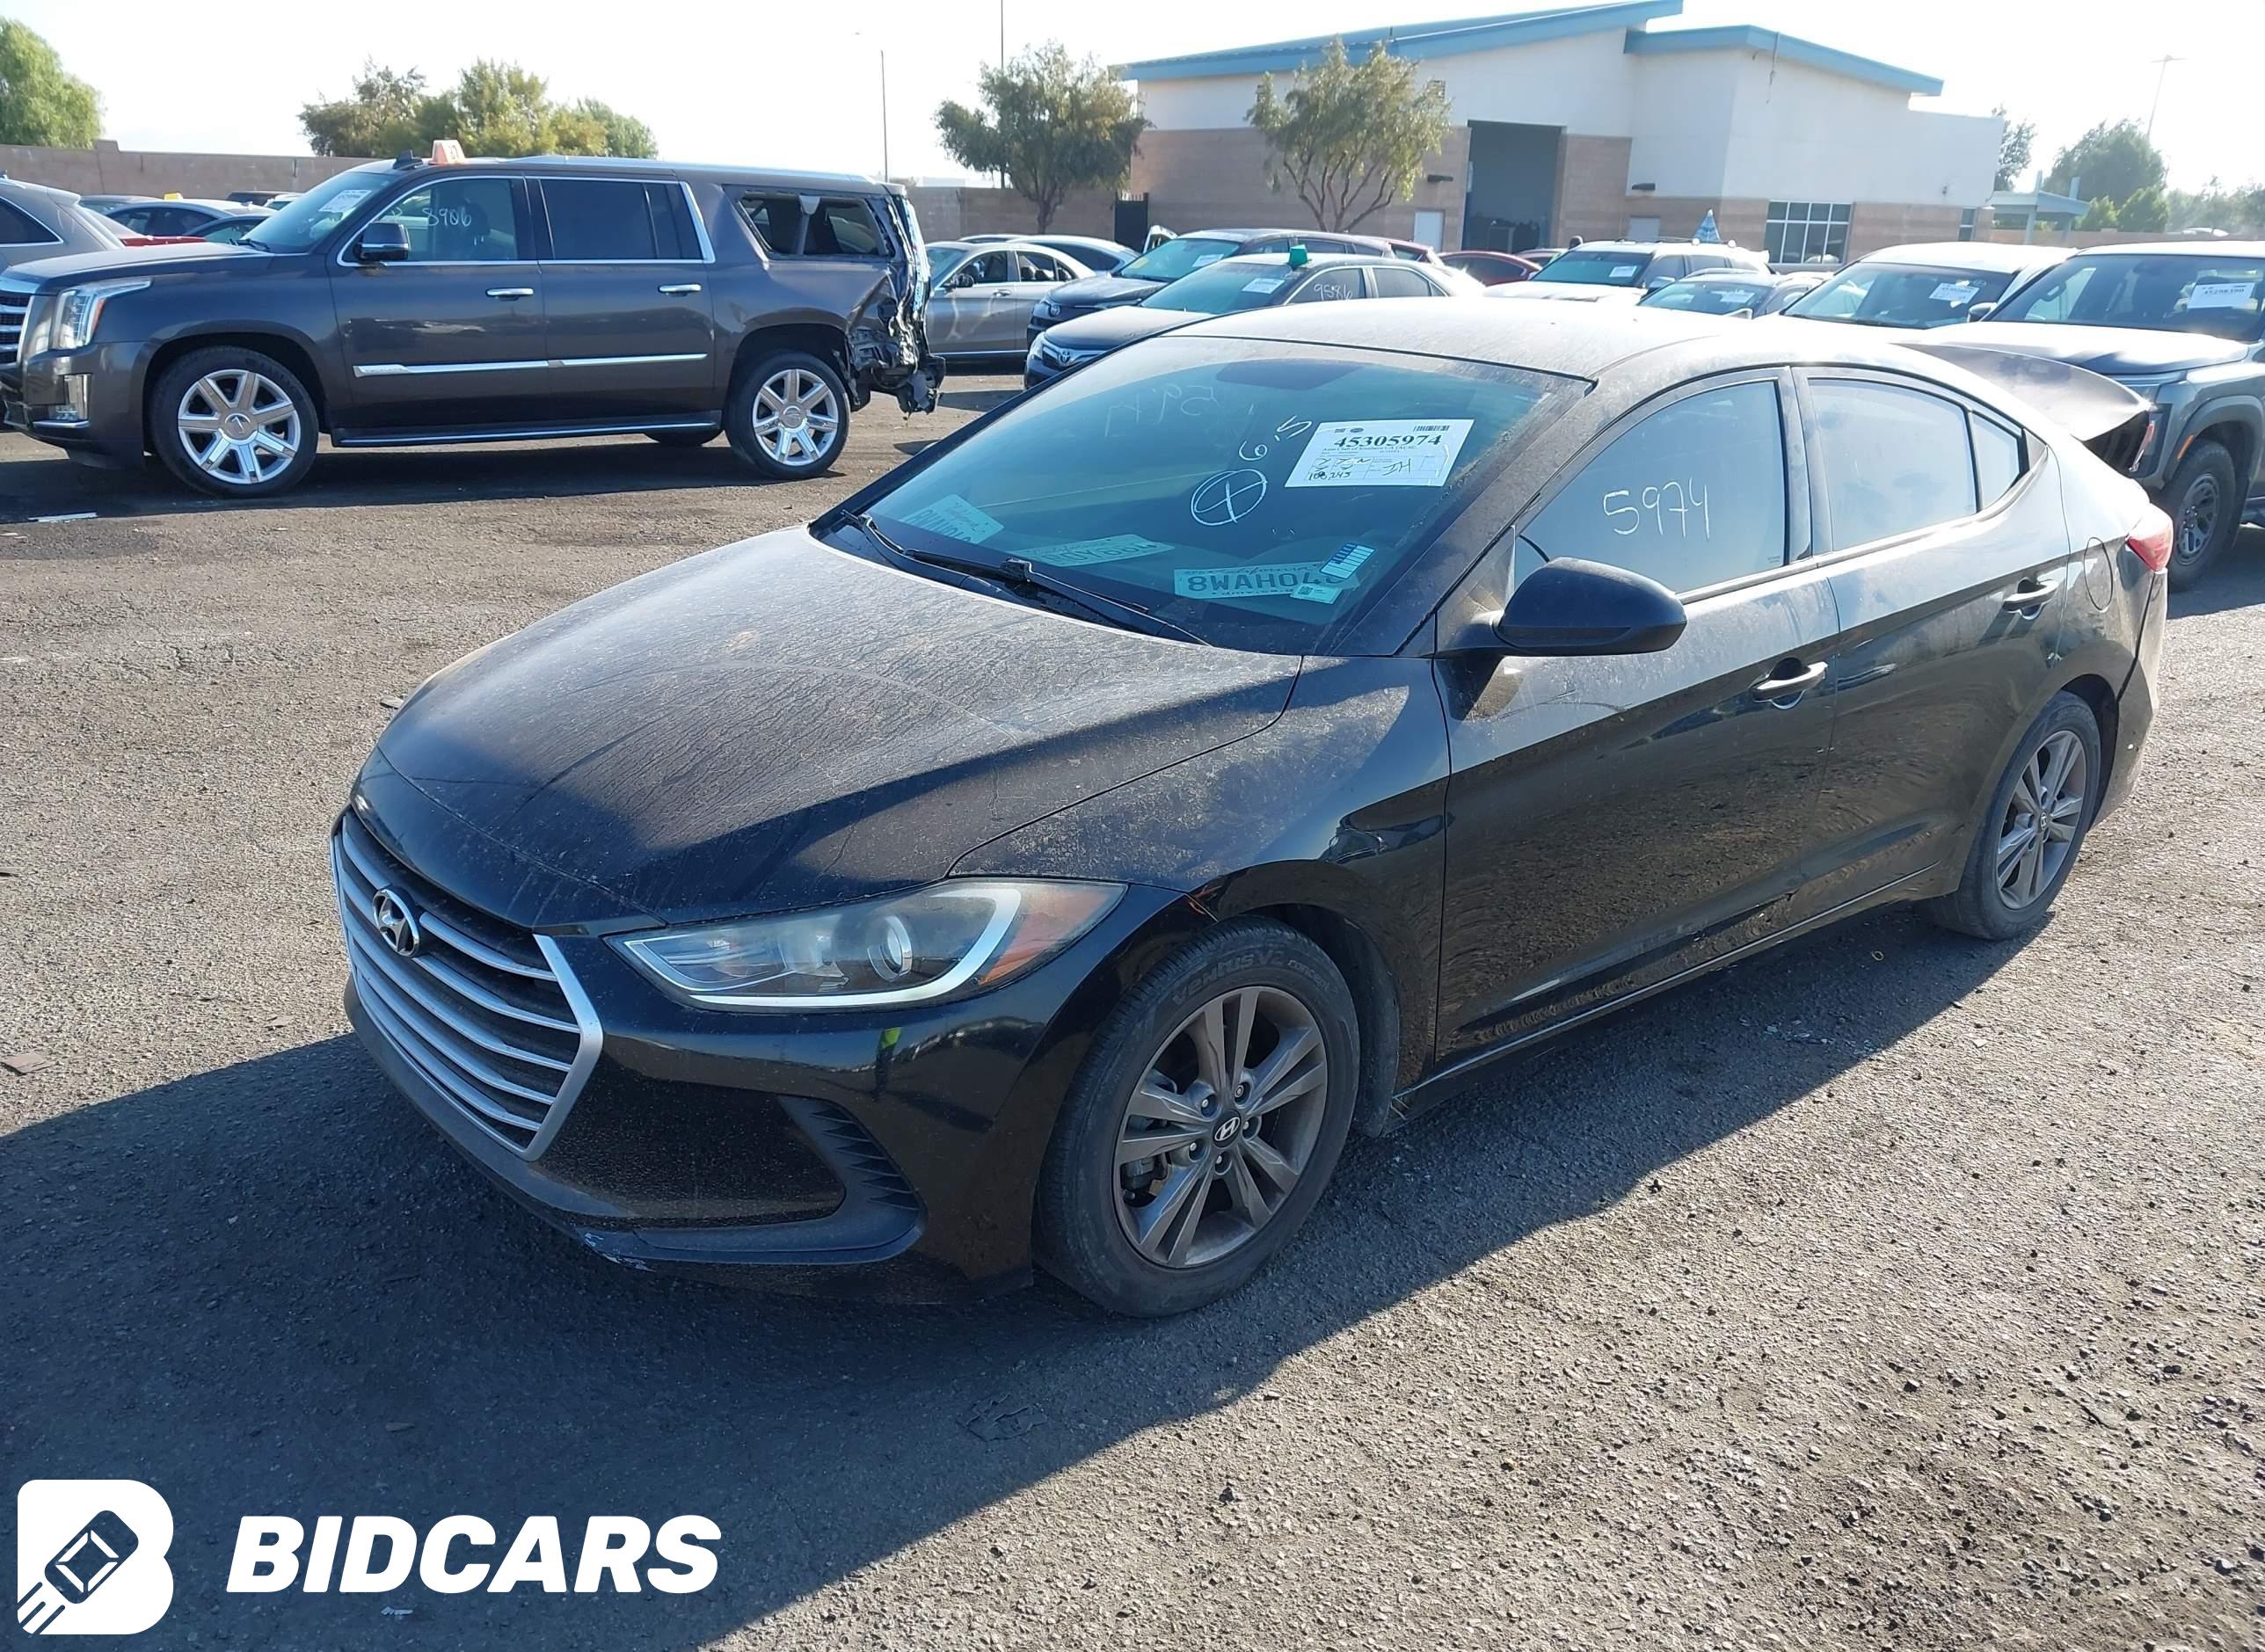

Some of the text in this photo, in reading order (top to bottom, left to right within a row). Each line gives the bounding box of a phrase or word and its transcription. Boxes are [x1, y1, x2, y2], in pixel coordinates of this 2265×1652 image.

[422, 207, 472, 227] 8906
[1333, 434, 1442, 448] 45305974
[1603, 478, 1710, 541] 5974
